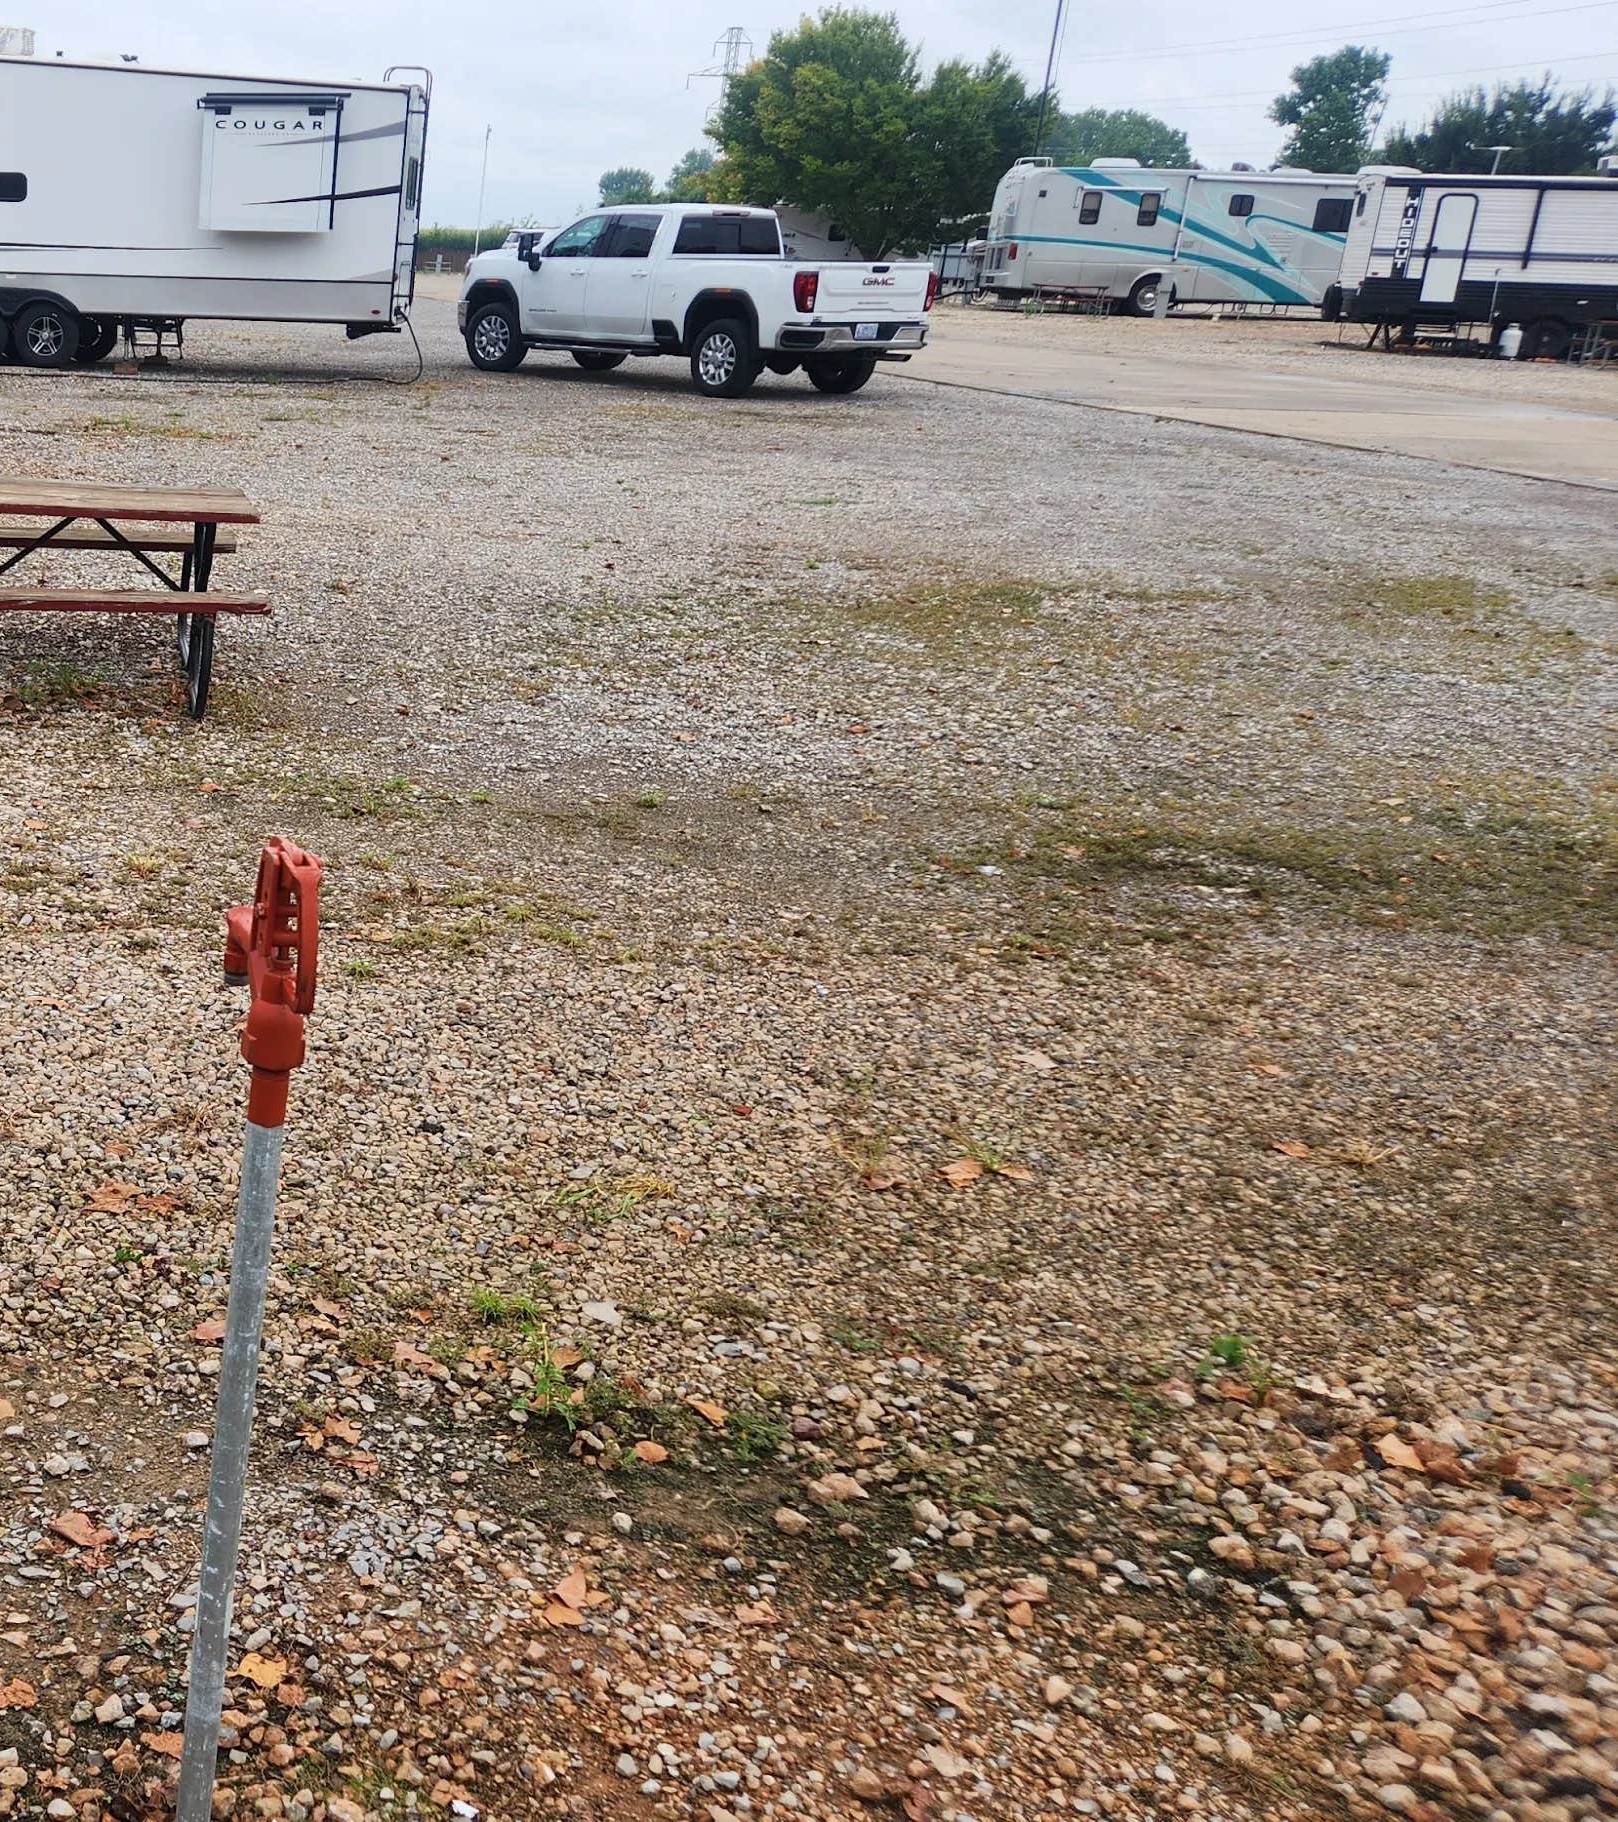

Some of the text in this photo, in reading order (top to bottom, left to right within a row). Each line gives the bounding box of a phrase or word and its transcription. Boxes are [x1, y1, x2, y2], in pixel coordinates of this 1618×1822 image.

[215, 120, 322, 130] COUGAR
[1394, 196, 1420, 269] HIDEOUT
[862, 277, 895, 286] GMC
